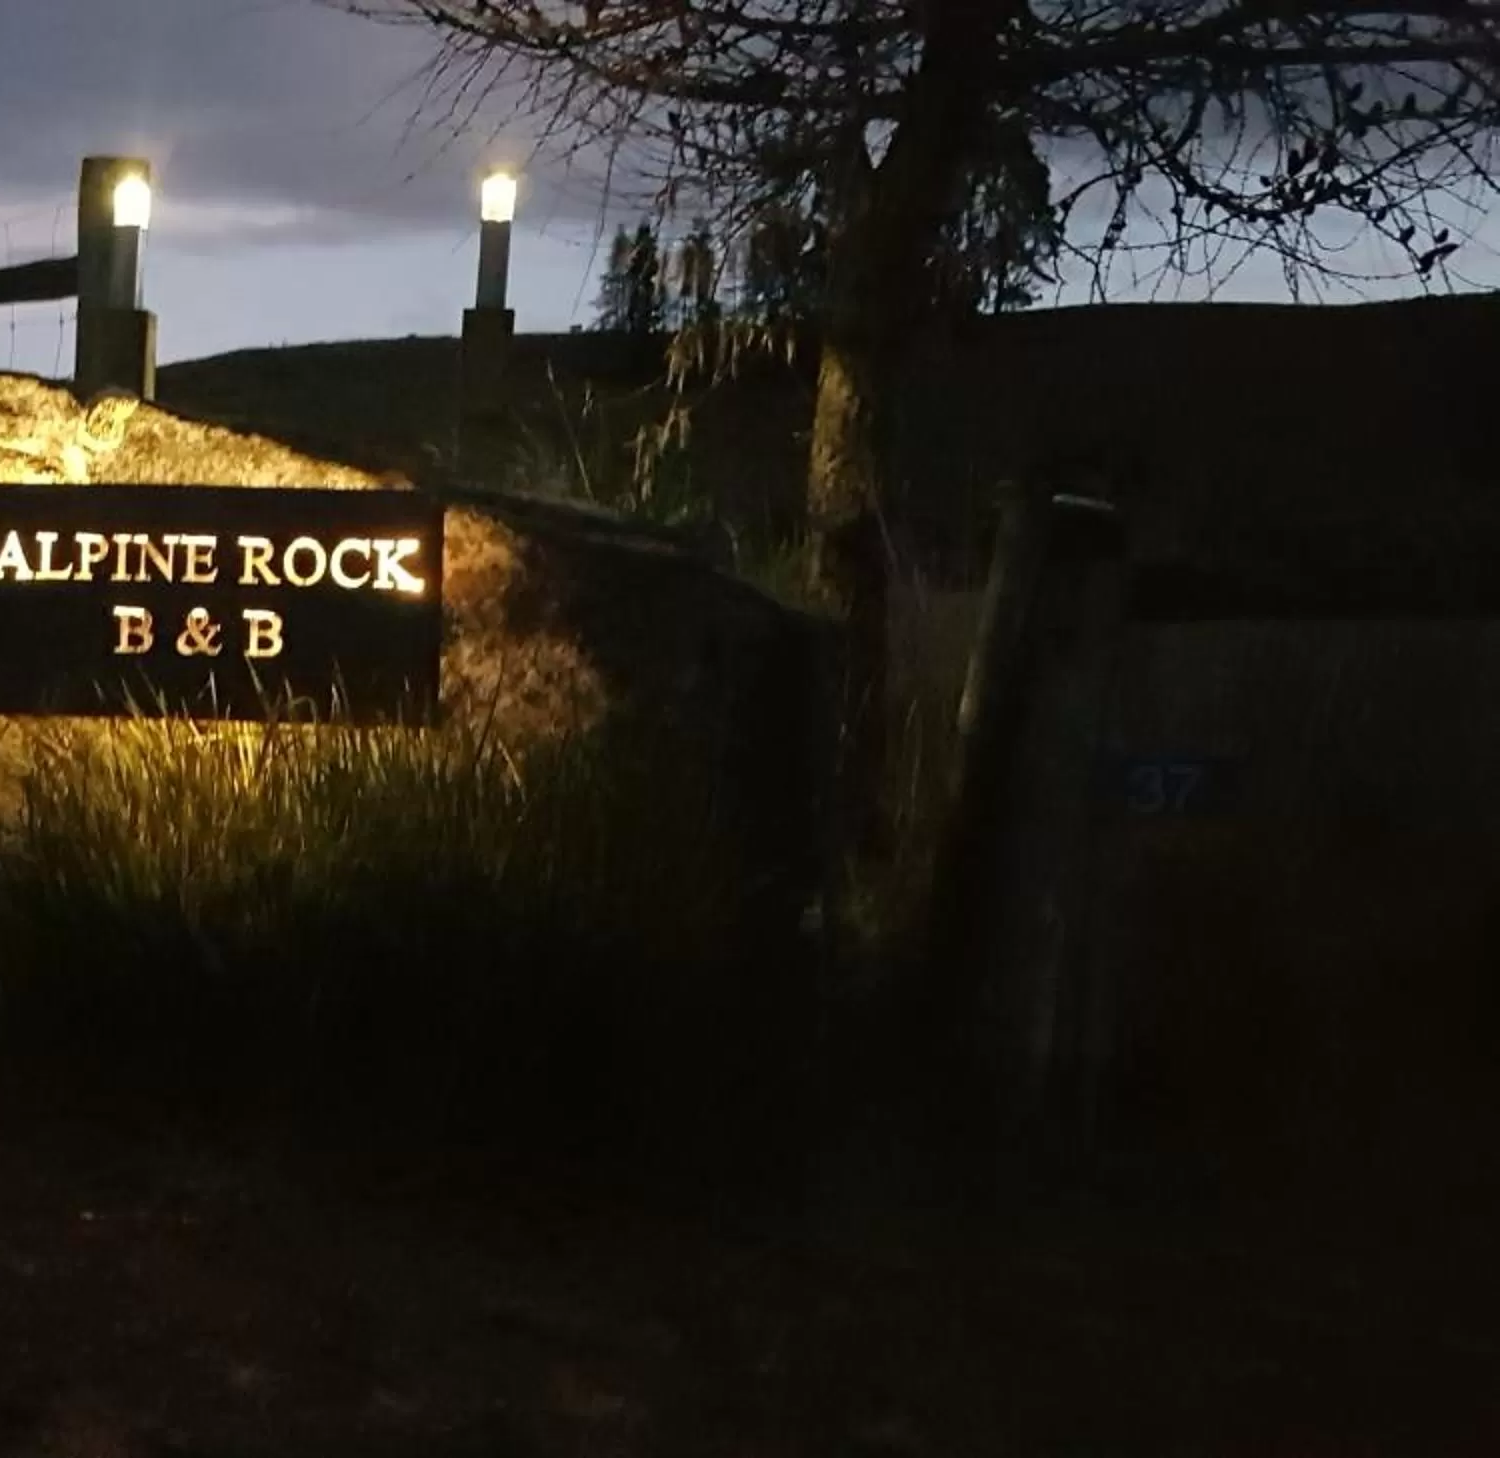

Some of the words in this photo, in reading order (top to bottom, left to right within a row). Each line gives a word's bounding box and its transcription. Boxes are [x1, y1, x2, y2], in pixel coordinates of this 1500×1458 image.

[235, 534, 426, 595] ROCK
[112, 605, 156, 656] B
[175, 606, 223, 658] &
[242, 608, 286, 660] B
[1128, 761, 1203, 814] 37
